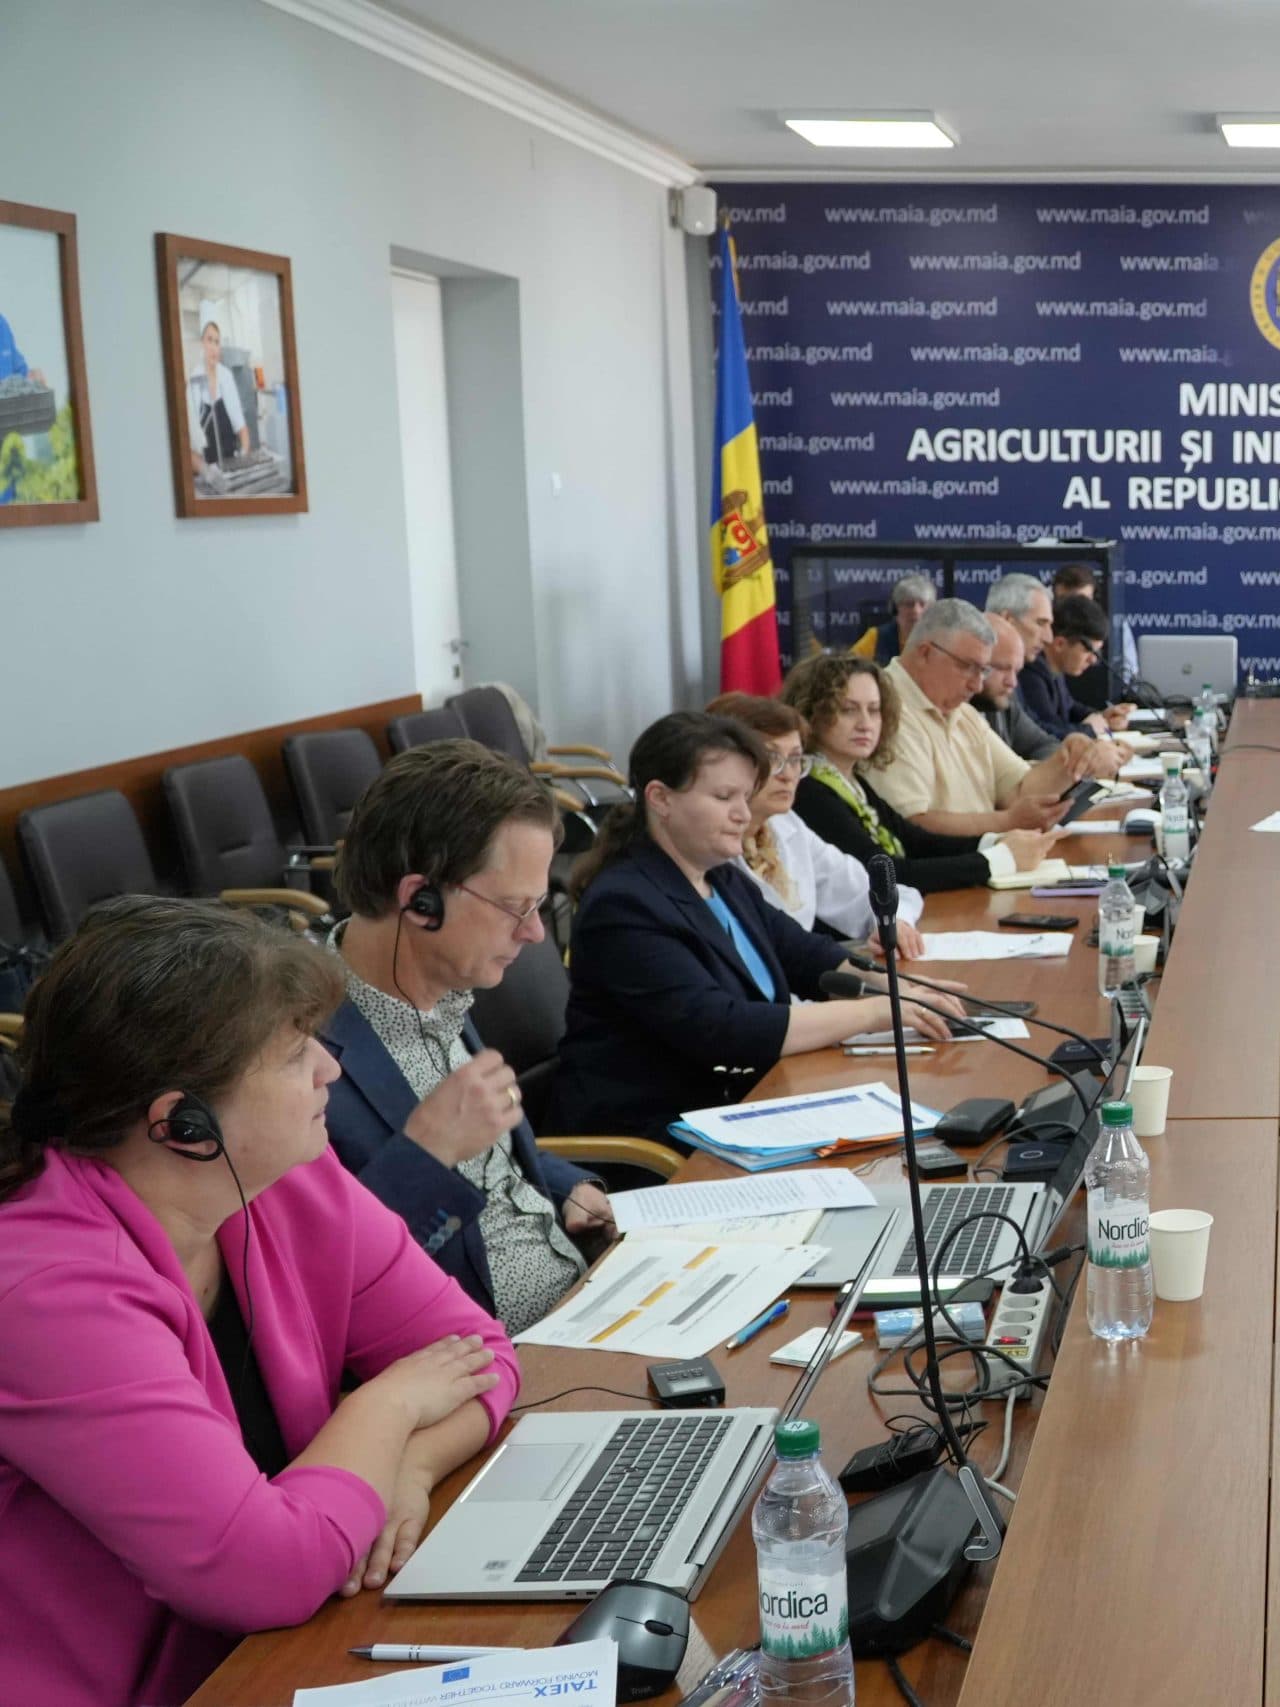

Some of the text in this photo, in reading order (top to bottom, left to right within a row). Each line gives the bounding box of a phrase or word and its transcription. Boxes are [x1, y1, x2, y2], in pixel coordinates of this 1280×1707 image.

[825, 204, 998, 227] www.maia.gov.md
[1036, 205, 1209, 228] www.maia.gov.md
[710, 250, 871, 275] w.maia.gov.md
[910, 251, 1081, 274] www.maia.gov.md
[827, 296, 998, 320] www.maia.gov.md
[1036, 299, 1207, 320] www.maia.gov.md
[744, 341, 873, 366] .maia.gov.md
[911, 343, 1080, 365] www.maia.gov.md
[831, 387, 1000, 410] www.maia.gov.md
[758, 431, 876, 456] maia.gov.md
[907, 429, 1161, 462] AGRICULTURII
[1181, 430, 1212, 472] ȘI
[830, 477, 999, 499] www.maia.gov.md
[1063, 477, 1110, 509] AL
[767, 519, 877, 542] maia.gov.md
[761, 1591, 829, 1620] ordica
[533, 1678, 598, 1698] TAIEX
